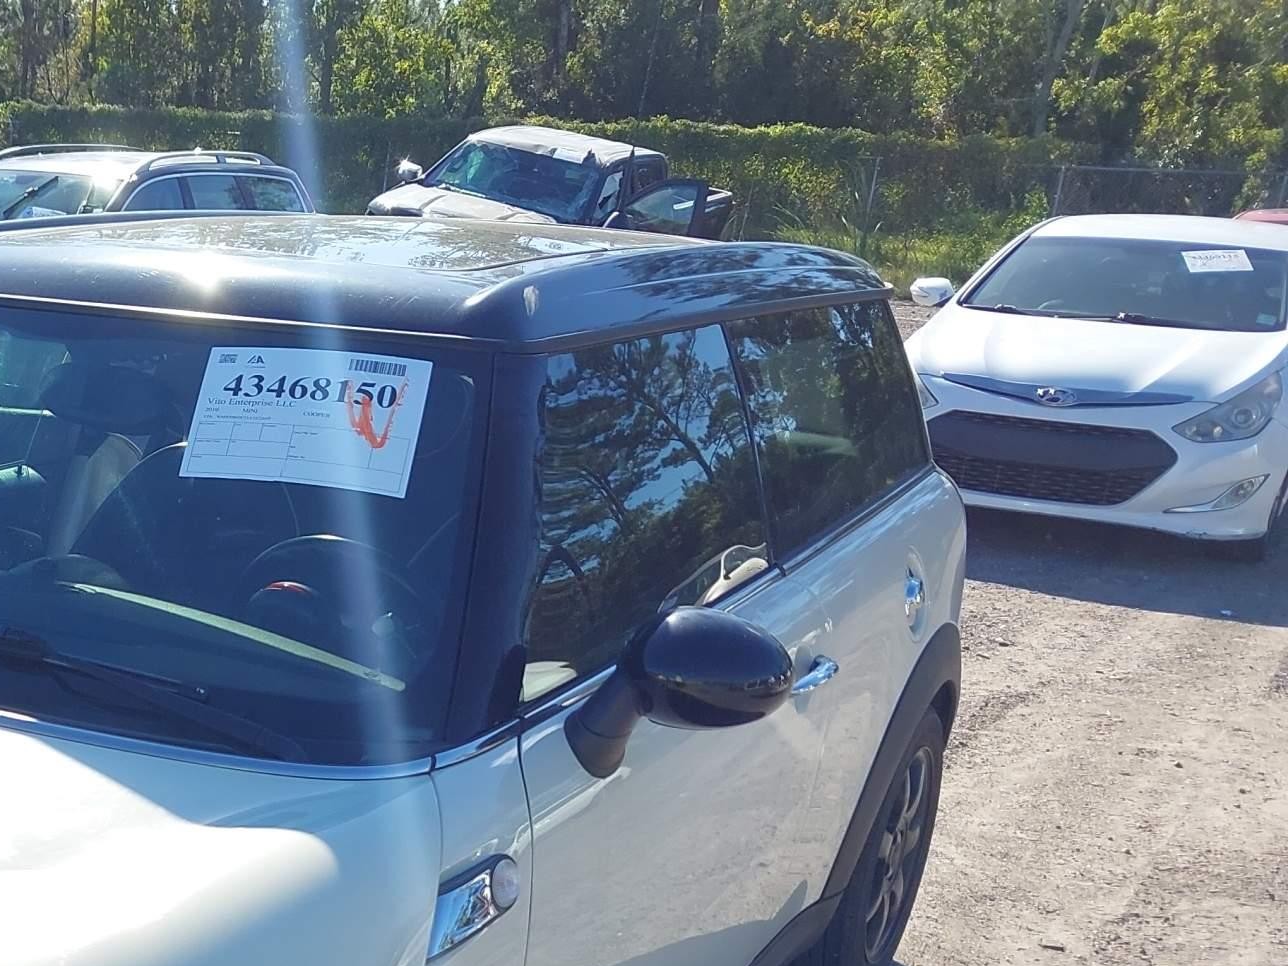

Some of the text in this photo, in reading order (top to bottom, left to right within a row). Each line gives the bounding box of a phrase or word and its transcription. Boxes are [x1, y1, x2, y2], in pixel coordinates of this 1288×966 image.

[223, 374, 397, 409] 43468150
[228, 398, 273, 408] Enterprise
[275, 400, 296, 408] LLC
